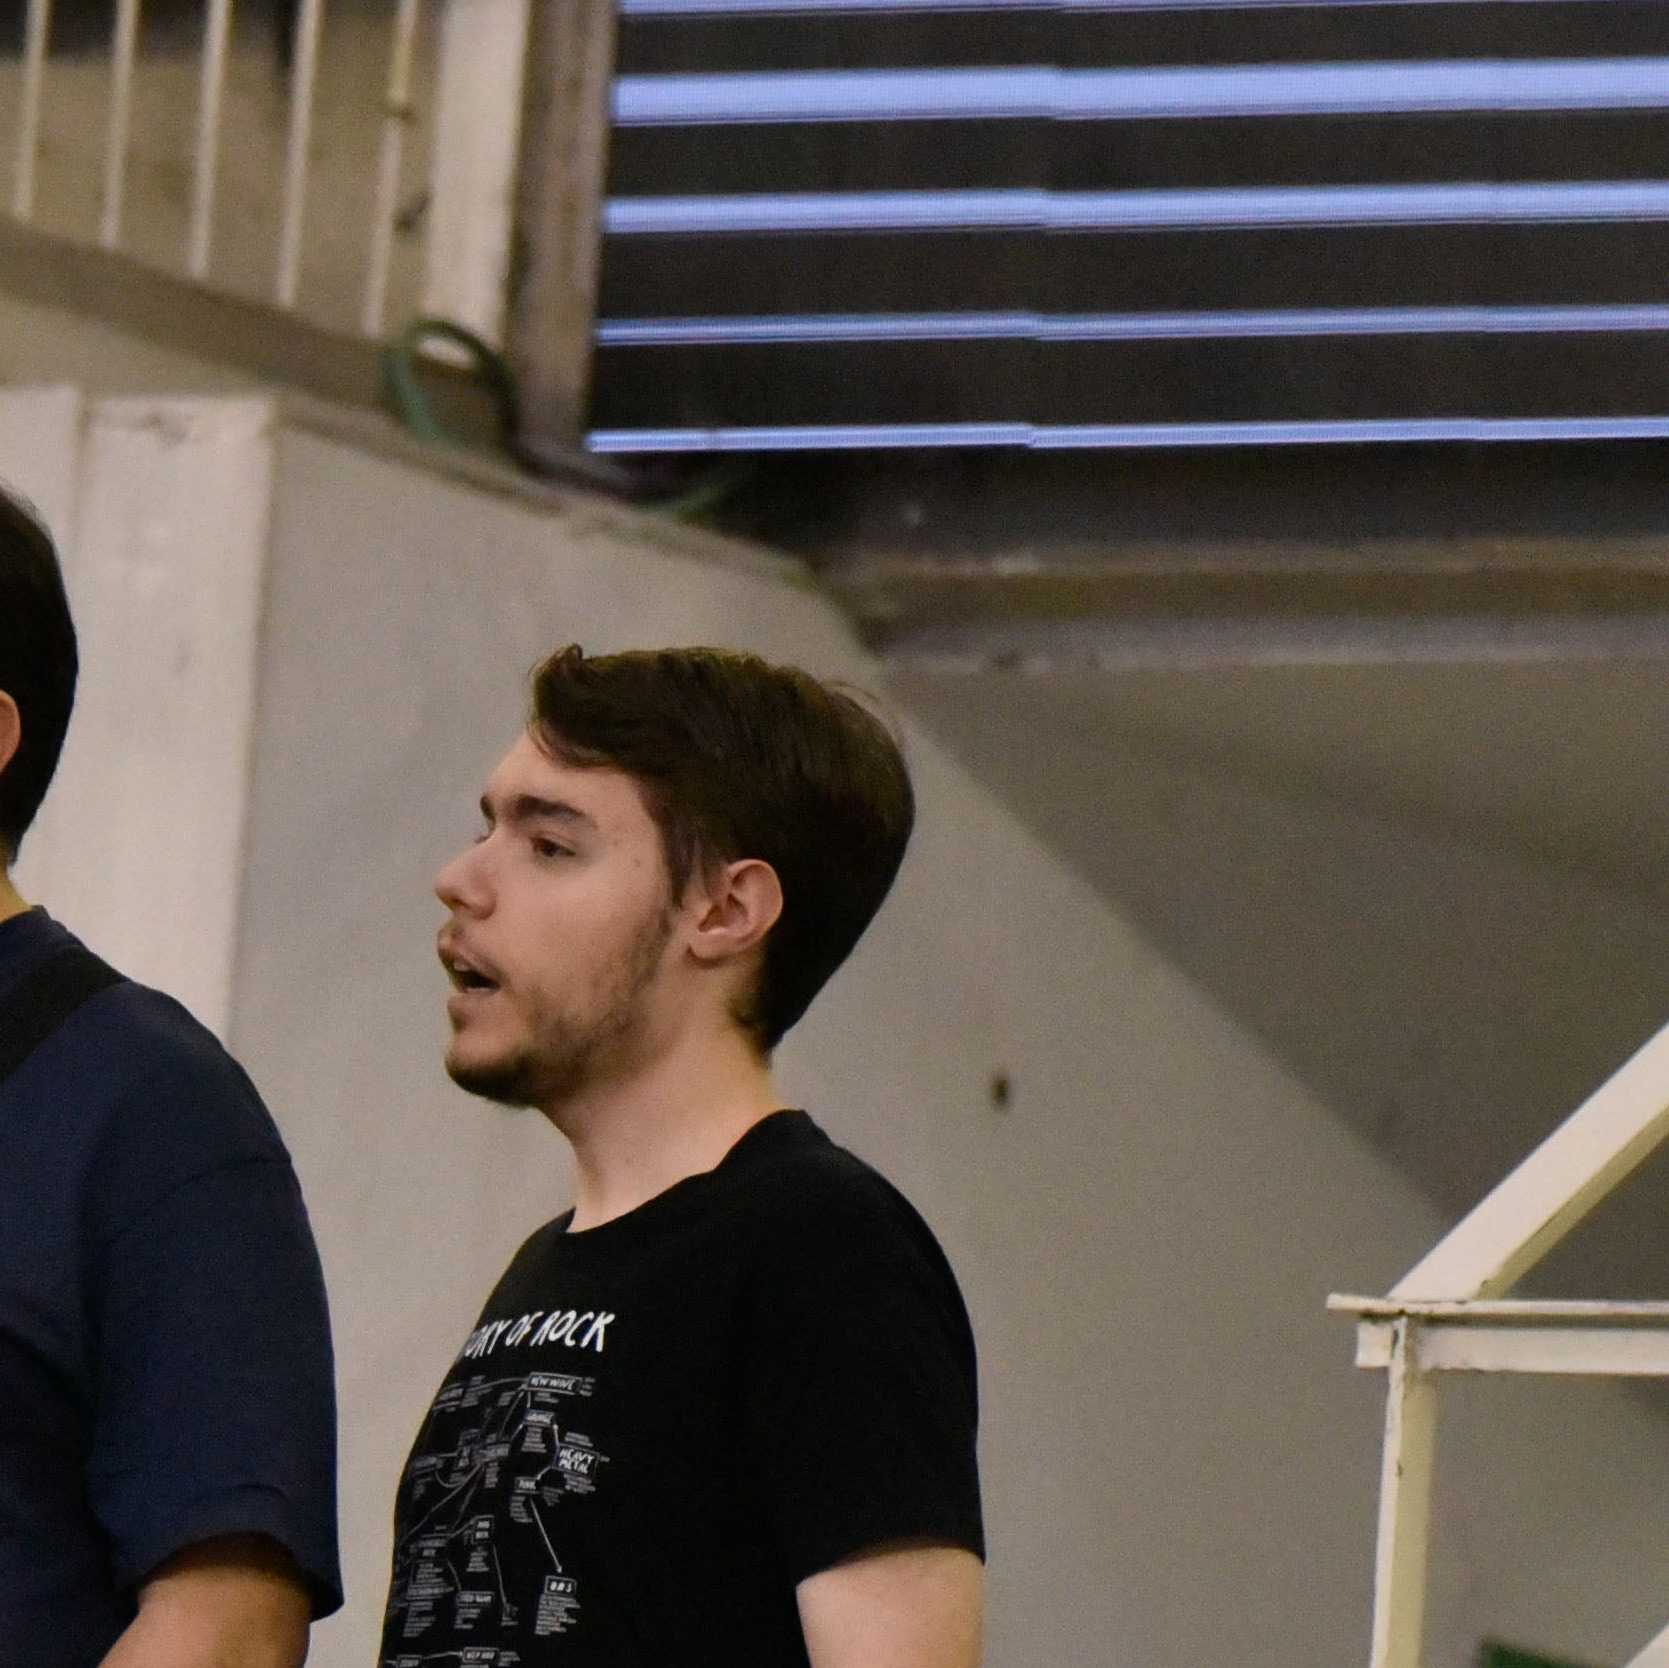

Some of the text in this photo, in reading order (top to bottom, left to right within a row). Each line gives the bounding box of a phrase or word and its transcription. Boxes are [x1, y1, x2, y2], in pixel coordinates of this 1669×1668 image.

[505, 1310, 544, 1348] OF
[529, 1309, 616, 1353] ROCK
[558, 1449, 596, 1465] HEAVY
[557, 1459, 590, 1475] METAL
